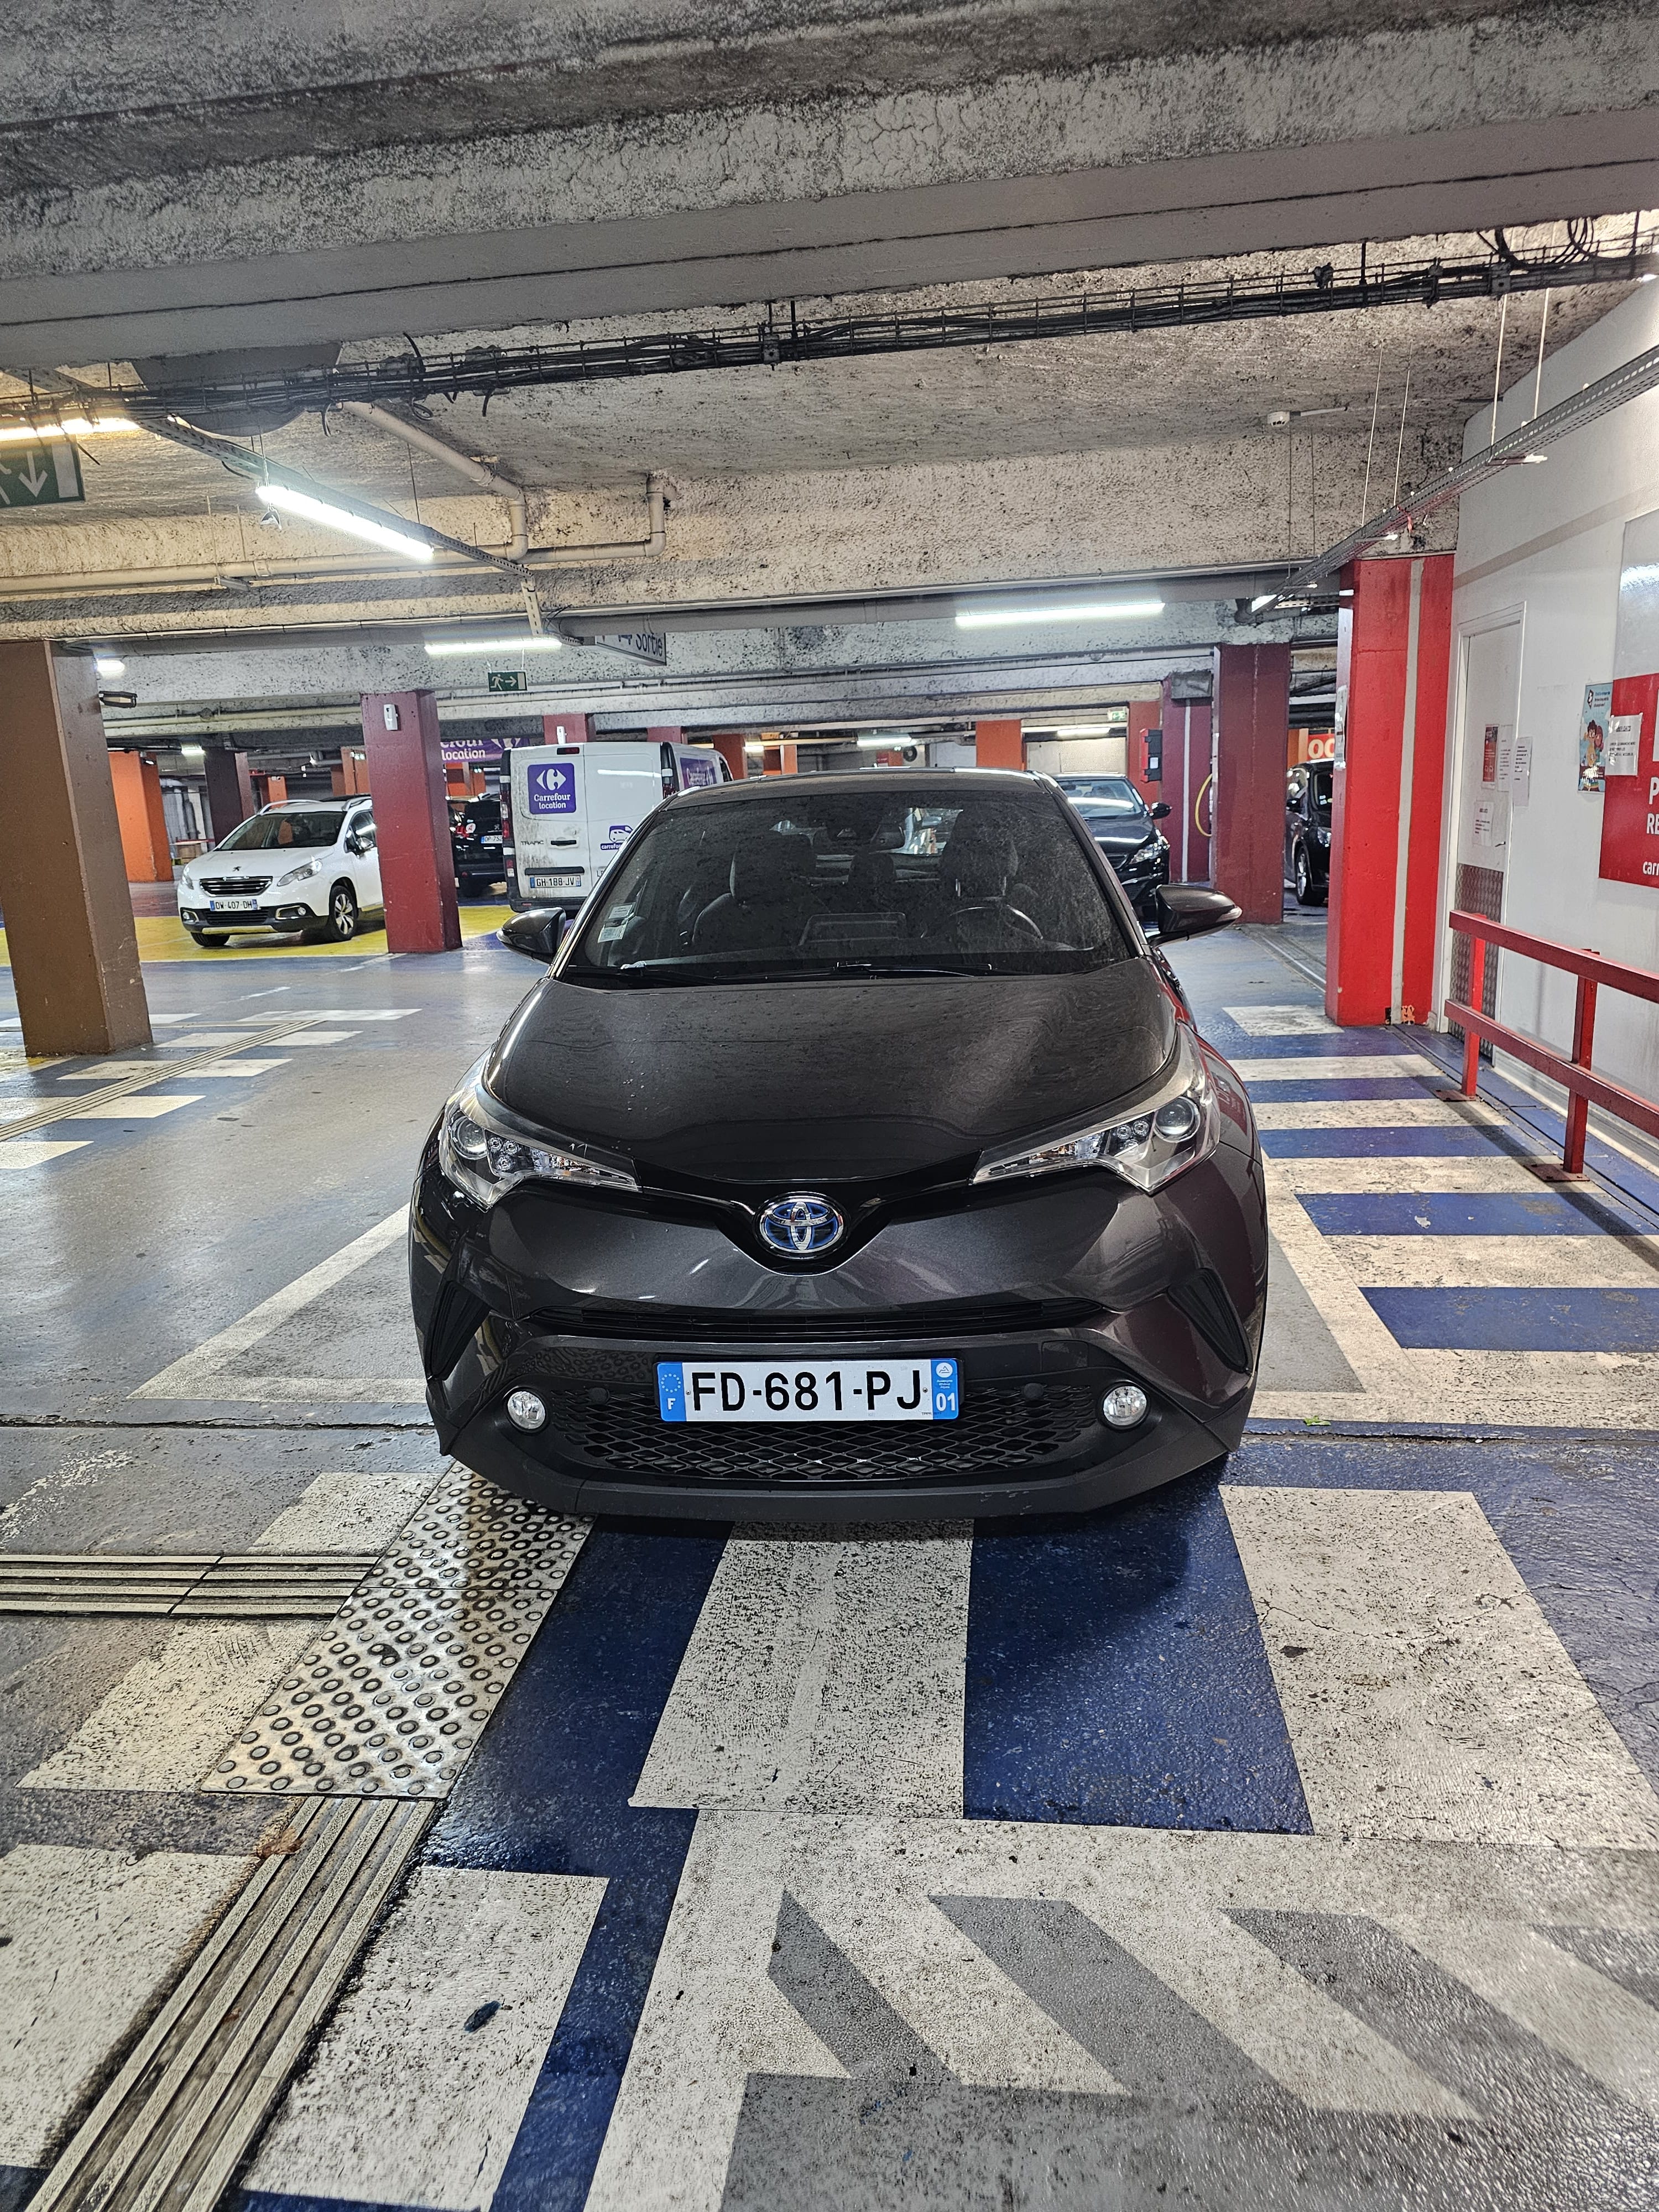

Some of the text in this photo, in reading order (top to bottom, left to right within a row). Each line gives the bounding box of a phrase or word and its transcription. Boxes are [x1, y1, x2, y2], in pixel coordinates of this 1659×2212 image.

[636, 634, 662, 657] Sortie
[441, 748, 486, 760] location
[534, 792, 571, 801] Carrefour
[1646, 813, 1659, 835] RE
[691, 1370, 921, 1411] FD-681-PJ
[667, 1398, 676, 1410] F
[936, 1392, 956, 1411] 01
